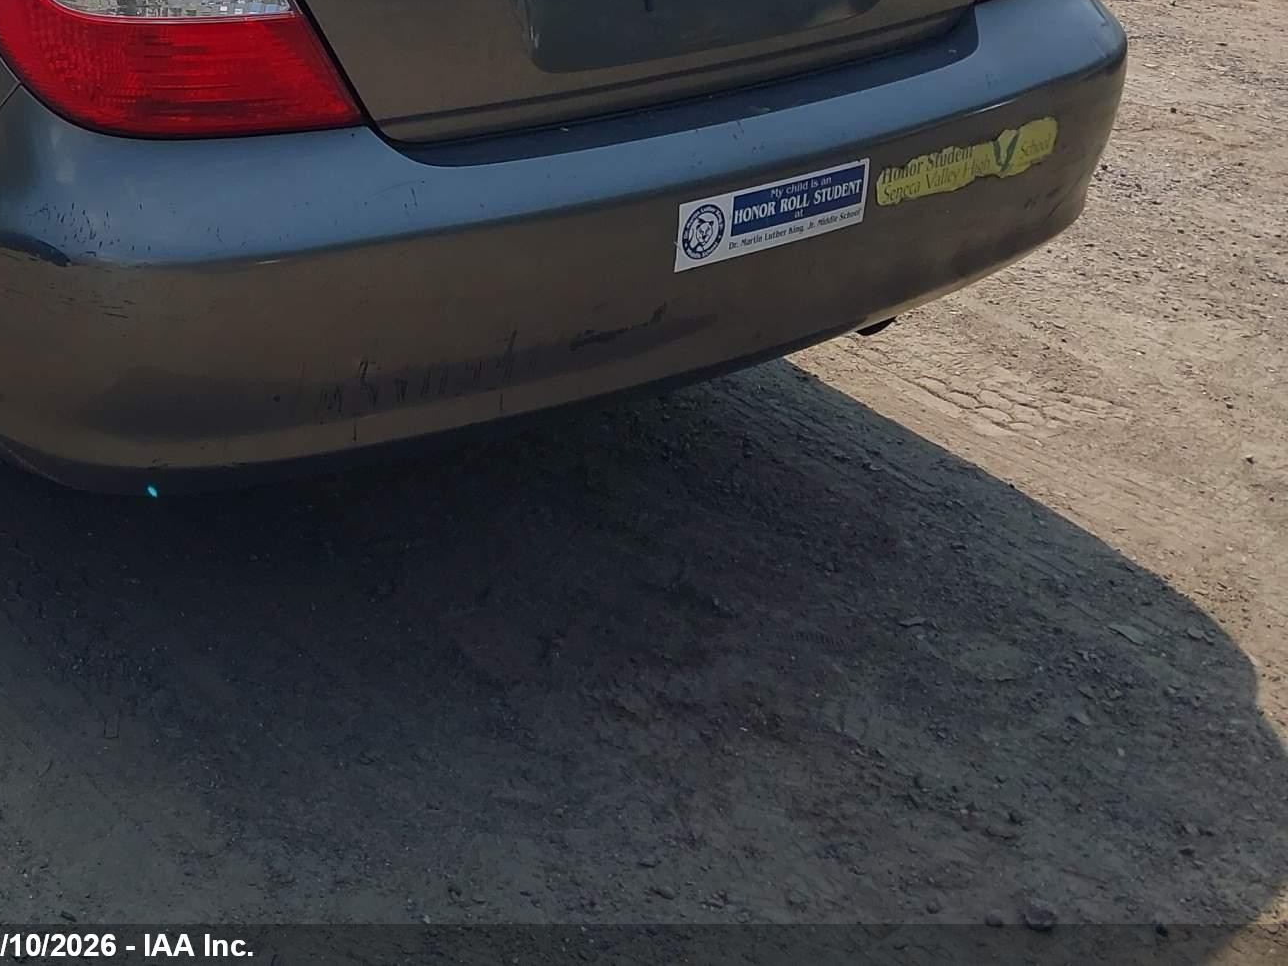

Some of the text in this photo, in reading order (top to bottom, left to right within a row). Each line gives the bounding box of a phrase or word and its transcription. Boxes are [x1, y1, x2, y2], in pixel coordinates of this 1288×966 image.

[882, 159, 925, 184] Honor
[770, 176, 832, 201] My child is an
[884, 180, 921, 204] Seneca
[734, 179, 862, 225] HONOR ROLL STUDENT
[794, 208, 804, 218] at
[728, 239, 739, 250] Dr.
[740, 234, 763, 247] Martin
[764, 227, 788, 242] Luther
[816, 215, 838, 228] Middle
[838, 208, 862, 222] School
